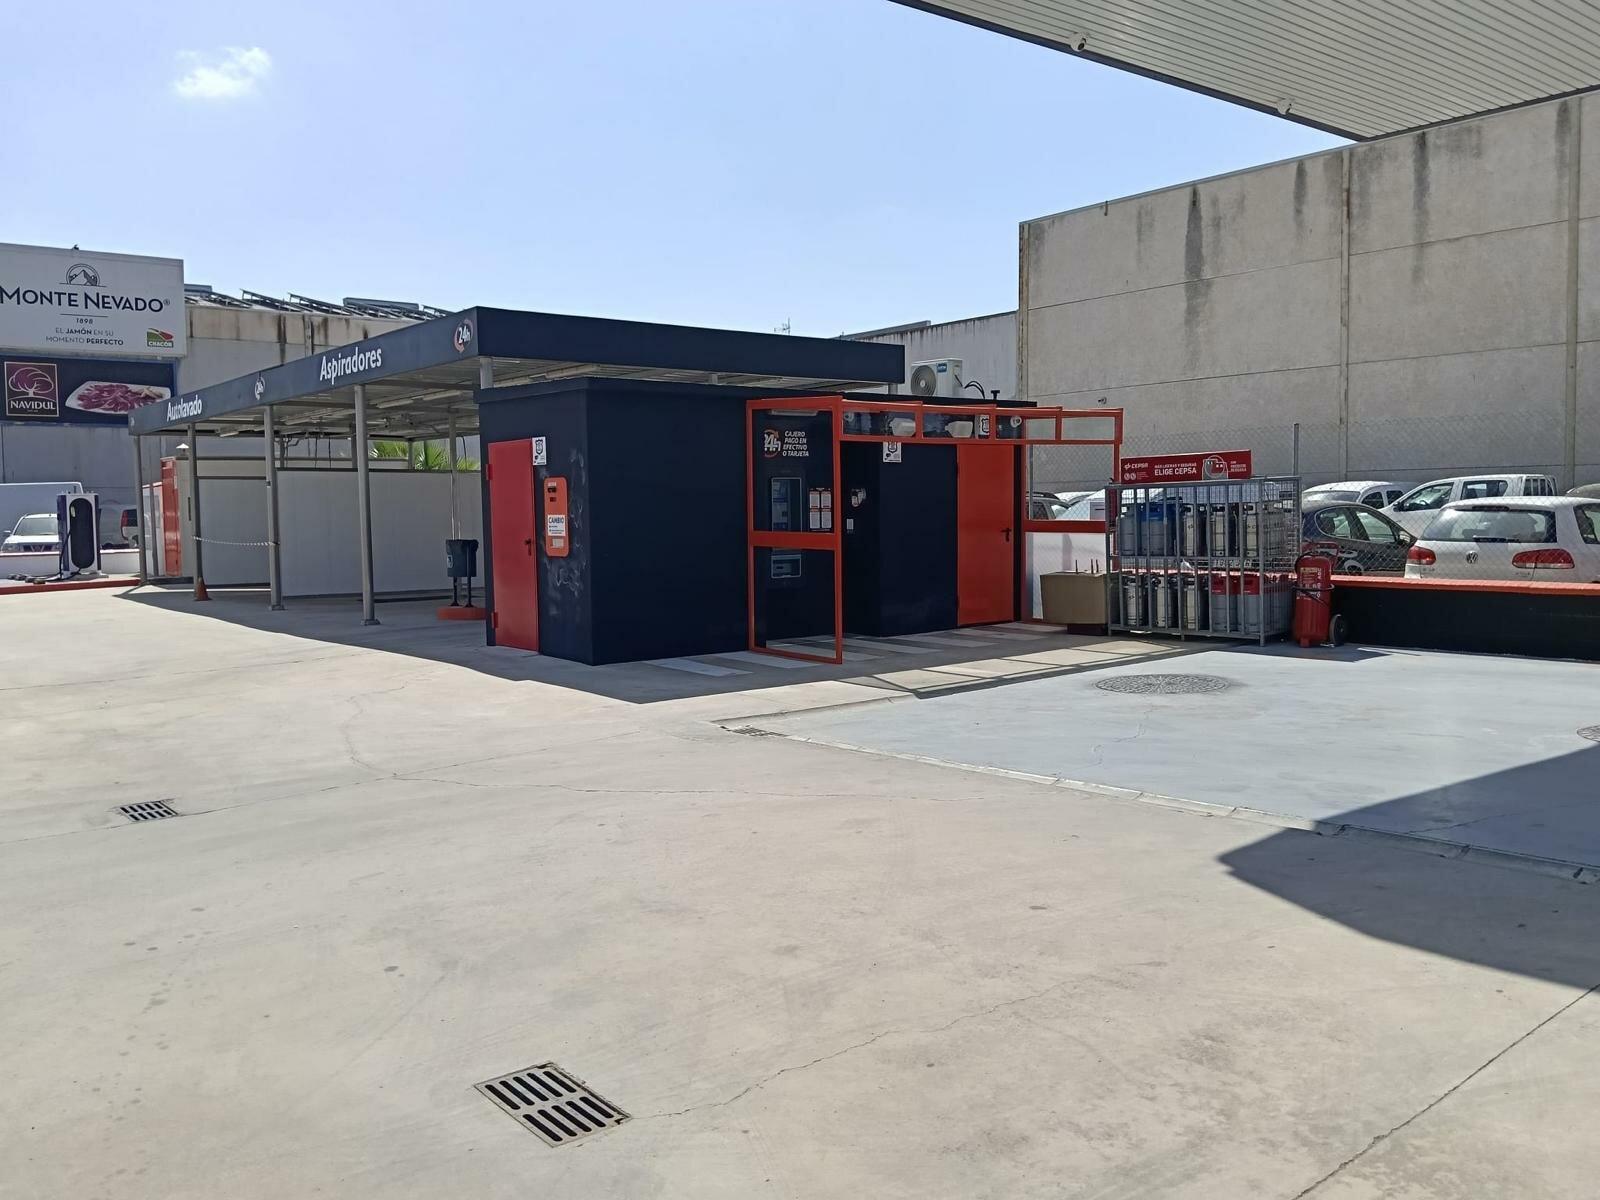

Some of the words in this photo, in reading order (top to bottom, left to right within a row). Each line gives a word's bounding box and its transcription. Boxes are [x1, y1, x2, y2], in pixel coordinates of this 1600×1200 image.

[0, 286, 79, 307] MONTE
[65, 327, 92, 335] JAMÓN
[46, 336, 85, 344] MOMENTO
[86, 337, 124, 346] PERFECTO
[319, 346, 382, 385] Aspiradores
[10, 400, 56, 410] NAVIDUL
[166, 394, 203, 422] Autolavado
